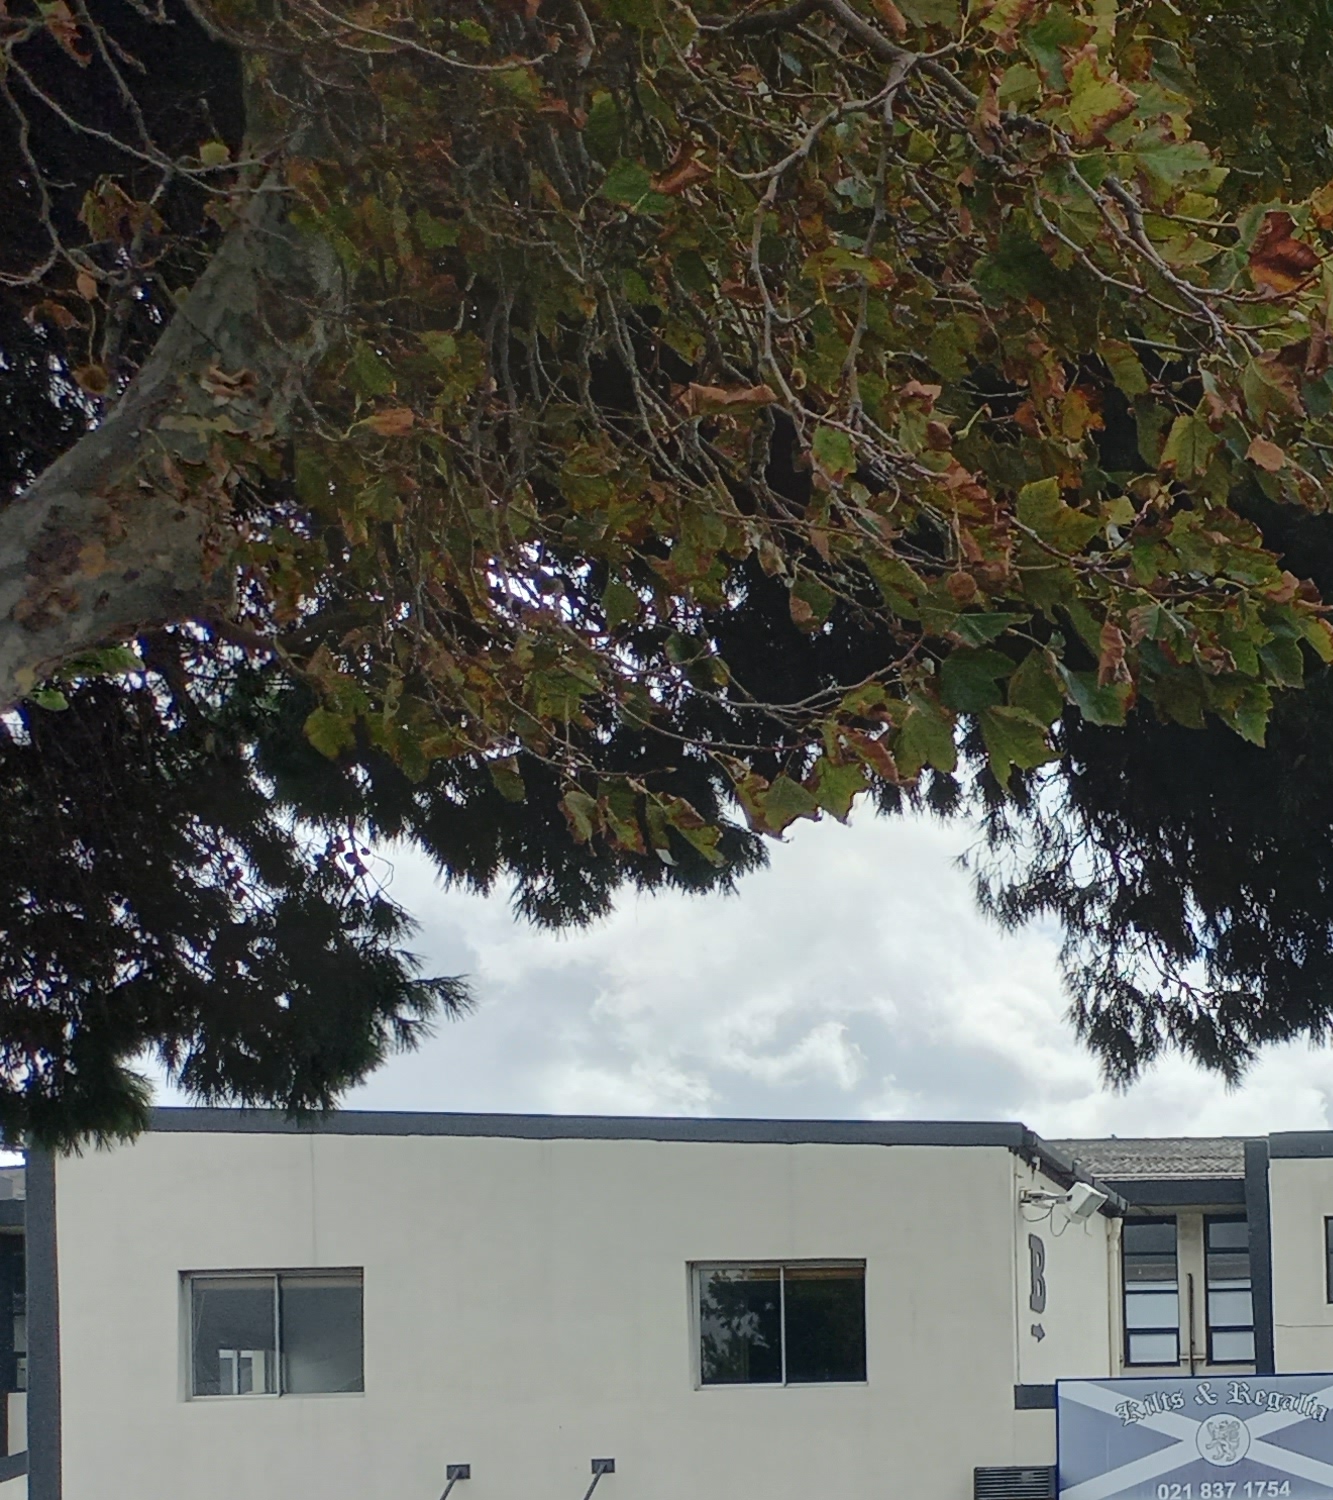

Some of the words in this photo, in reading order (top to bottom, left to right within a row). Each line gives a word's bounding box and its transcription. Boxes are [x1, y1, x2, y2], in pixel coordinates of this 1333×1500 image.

[1114, 1388, 1186, 1426] Kilts
[1193, 1381, 1219, 1405] &
[1225, 1381, 1330, 1423] Regalia
[1157, 1483, 1192, 1500] 021
[1199, 1481, 1235, 1500] 837
[1243, 1480, 1292, 1499] 1754
